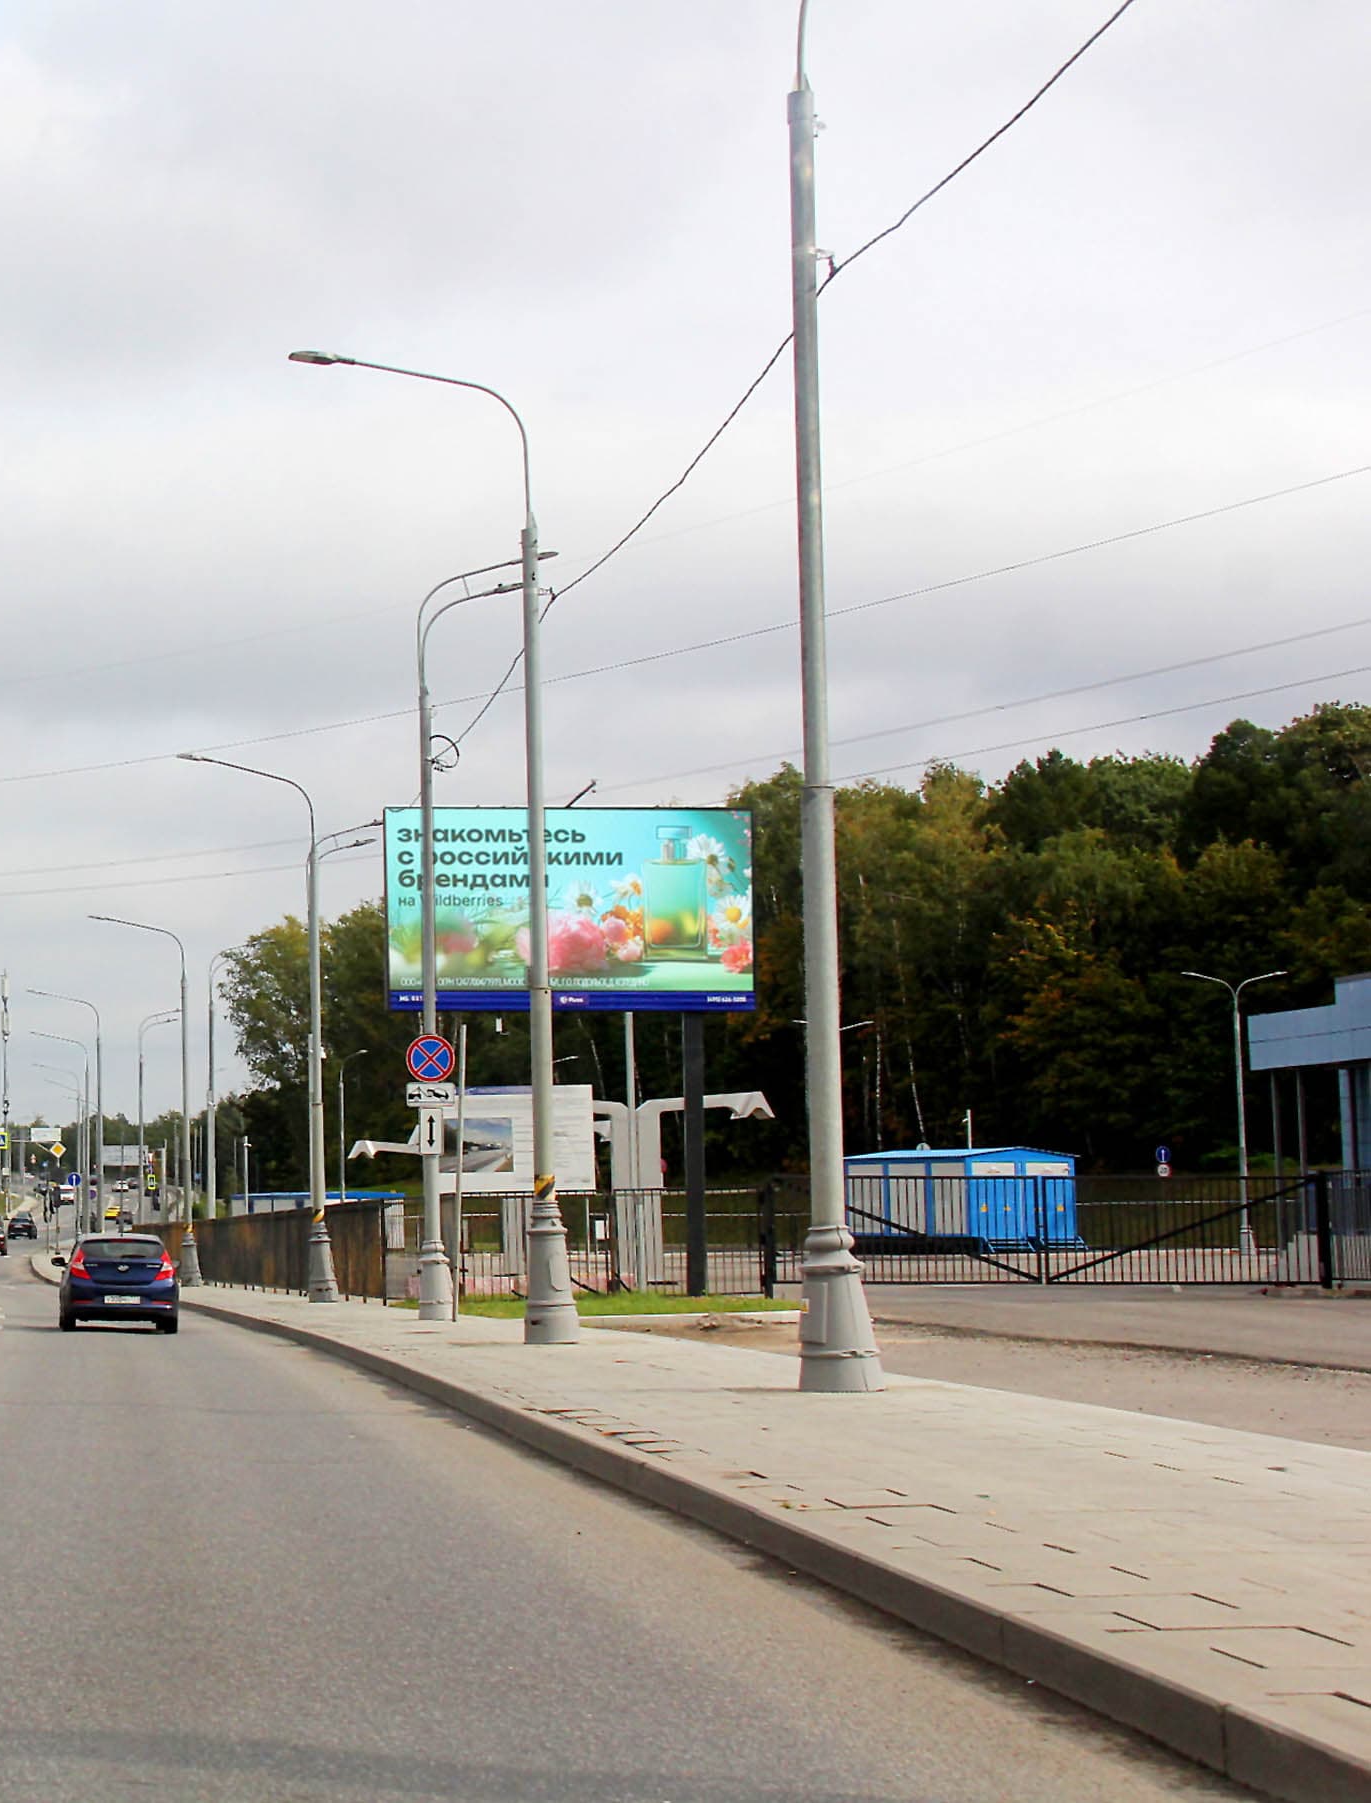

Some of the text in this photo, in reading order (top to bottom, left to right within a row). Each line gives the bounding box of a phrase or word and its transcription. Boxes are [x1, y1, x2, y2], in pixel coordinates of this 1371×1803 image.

[397, 846, 623, 866] с оссийкими
[398, 893, 504, 908] на ildberries
